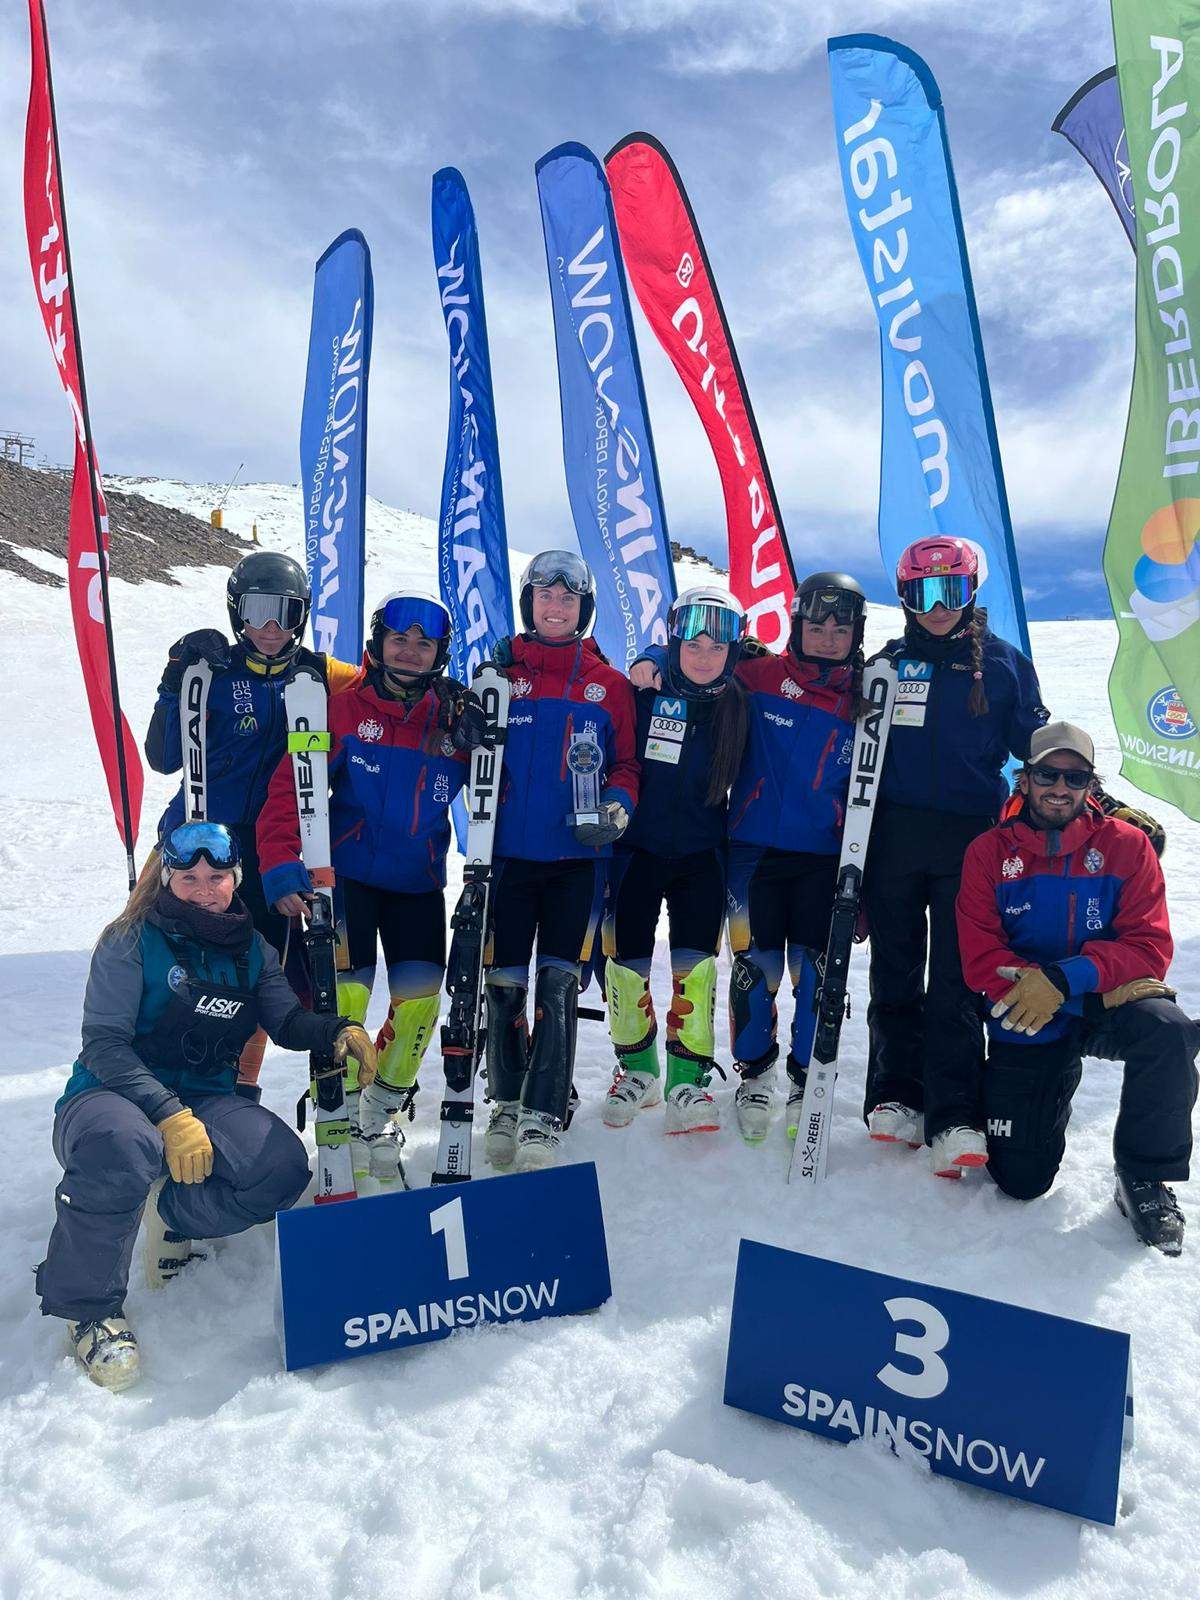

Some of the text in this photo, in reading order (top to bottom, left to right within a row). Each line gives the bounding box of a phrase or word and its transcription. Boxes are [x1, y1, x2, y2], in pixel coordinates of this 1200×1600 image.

[188, 676, 205, 820] HEAD
[473, 687, 500, 820] HED
[852, 677, 888, 807] HEAD
[196, 995, 241, 1015] LISKI
[411, 1026, 425, 1057] LEKI
[447, 1142, 459, 1175] REBEL
[807, 1111, 822, 1145] REBEL
[987, 1119, 1012, 1137] HH
[802, 1165, 813, 1178] SL
[429, 1196, 470, 1281] 1
[344, 1279, 559, 1348] SPAINSNOW
[876, 1297, 950, 1399] 3
[782, 1383, 1046, 1488] SPAINSNOW
